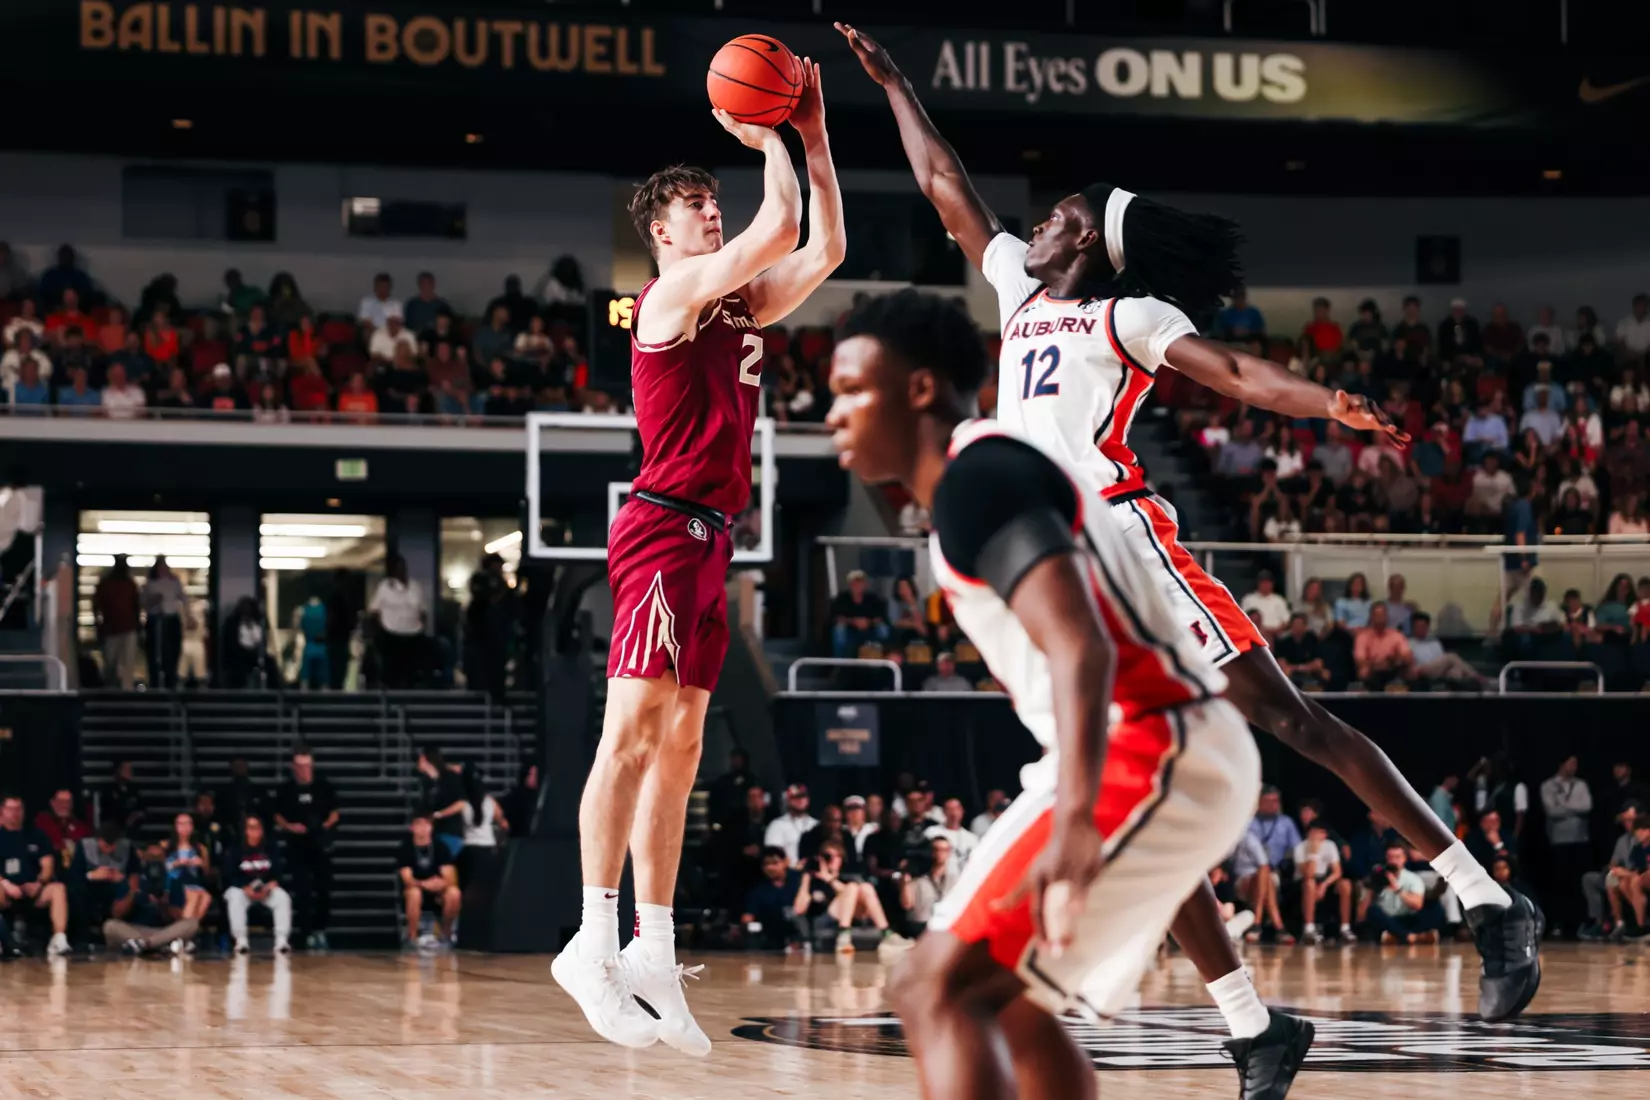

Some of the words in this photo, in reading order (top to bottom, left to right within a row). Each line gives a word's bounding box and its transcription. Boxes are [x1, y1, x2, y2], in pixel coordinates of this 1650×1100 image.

[79, 1, 266, 56] BALLIN
[290, 10, 342, 60] IN
[365, 14, 666, 76] BOUTWELL
[932, 40, 991, 90] All
[1003, 42, 1088, 103] Eyes
[1096, 48, 1202, 98] ON
[1213, 52, 1307, 102] US
[1009, 316, 1098, 341] AUBURN
[1020, 344, 1061, 400] 12
